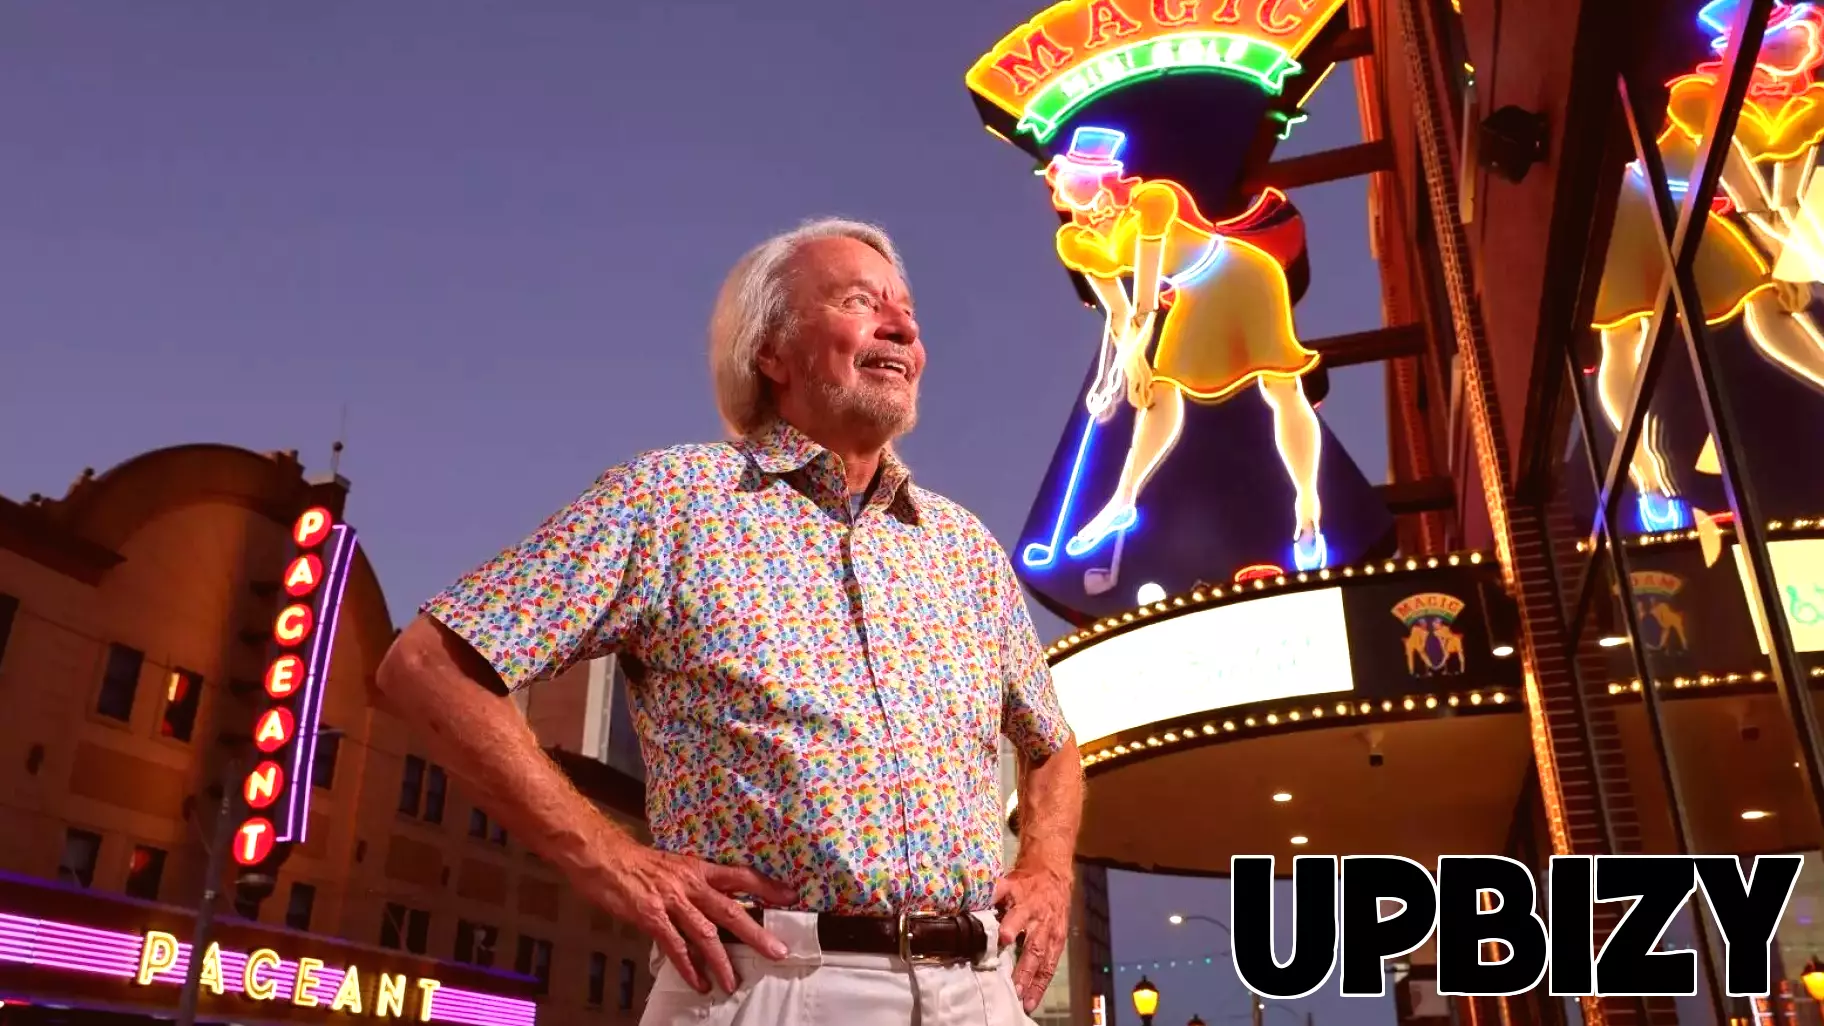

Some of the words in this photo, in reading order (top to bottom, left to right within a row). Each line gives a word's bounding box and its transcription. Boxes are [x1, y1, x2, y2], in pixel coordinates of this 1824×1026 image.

[991, 0, 1307, 96] MAGIC
[1396, 595, 1461, 617] MAGIC
[243, 510, 326, 861] PAGEANT
[137, 930, 441, 1022] PAGEANT
